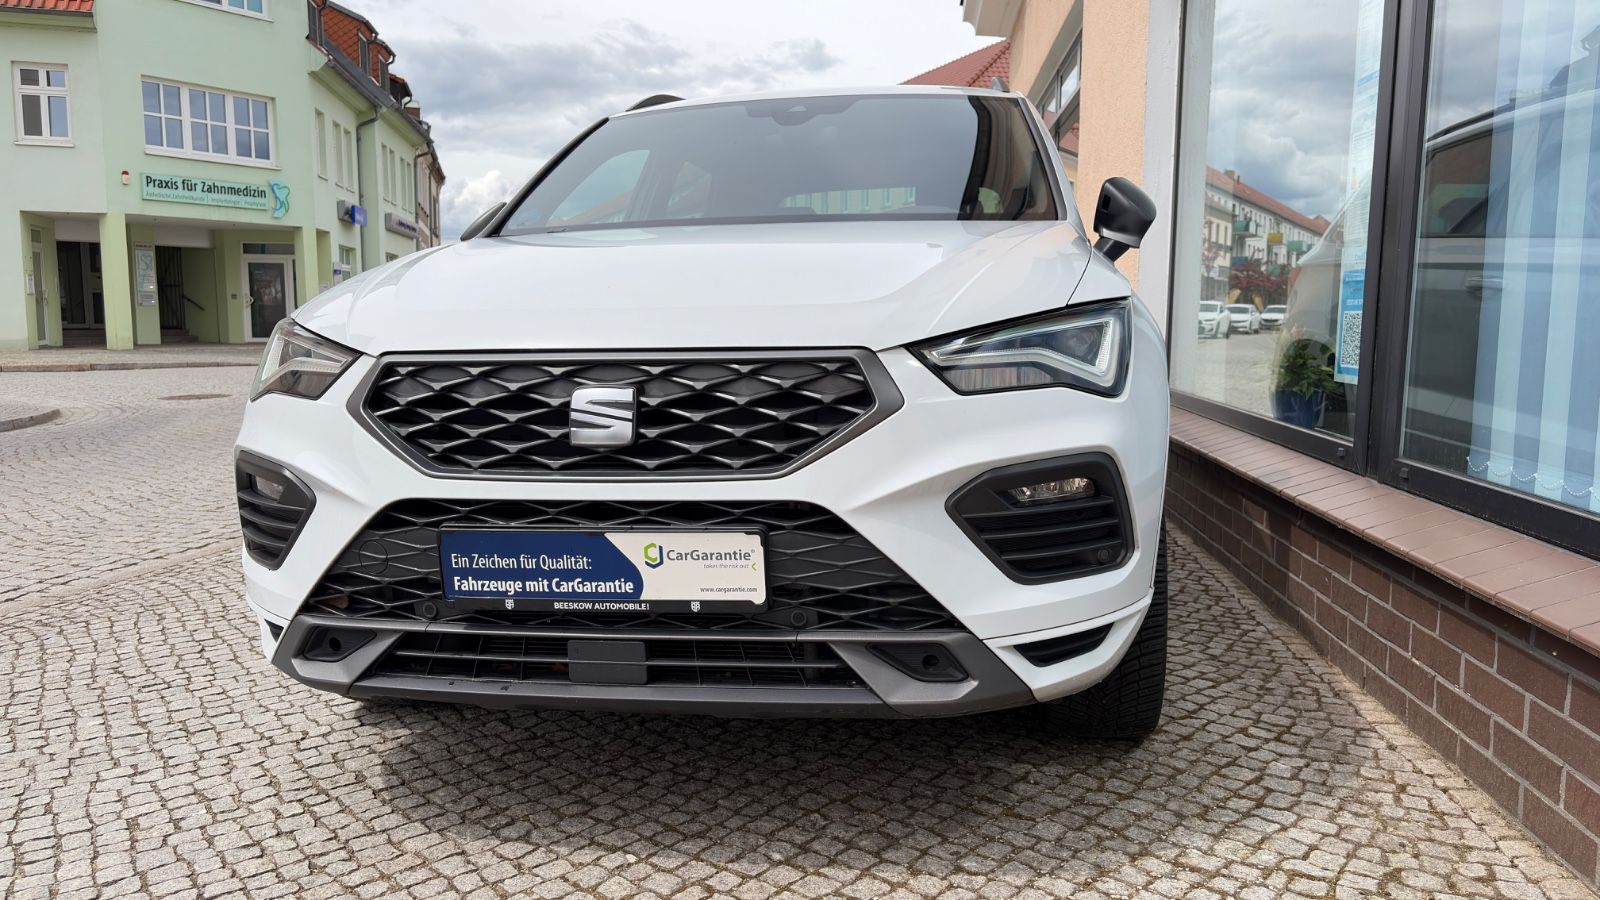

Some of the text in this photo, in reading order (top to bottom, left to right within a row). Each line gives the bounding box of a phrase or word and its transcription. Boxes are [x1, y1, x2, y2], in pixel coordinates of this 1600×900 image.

[146, 175, 179, 190] Praxis
[182, 178, 198, 192] für
[201, 181, 267, 199] Zahnmedizin
[451, 553, 592, 571] Ein Zeichen für Qualität:
[453, 576, 634, 595] Fahrzeuge mit CarGarantie
[700, 586, 758, 594] www.cargarantie.com
[554, 602, 593, 610] BEESKOW
